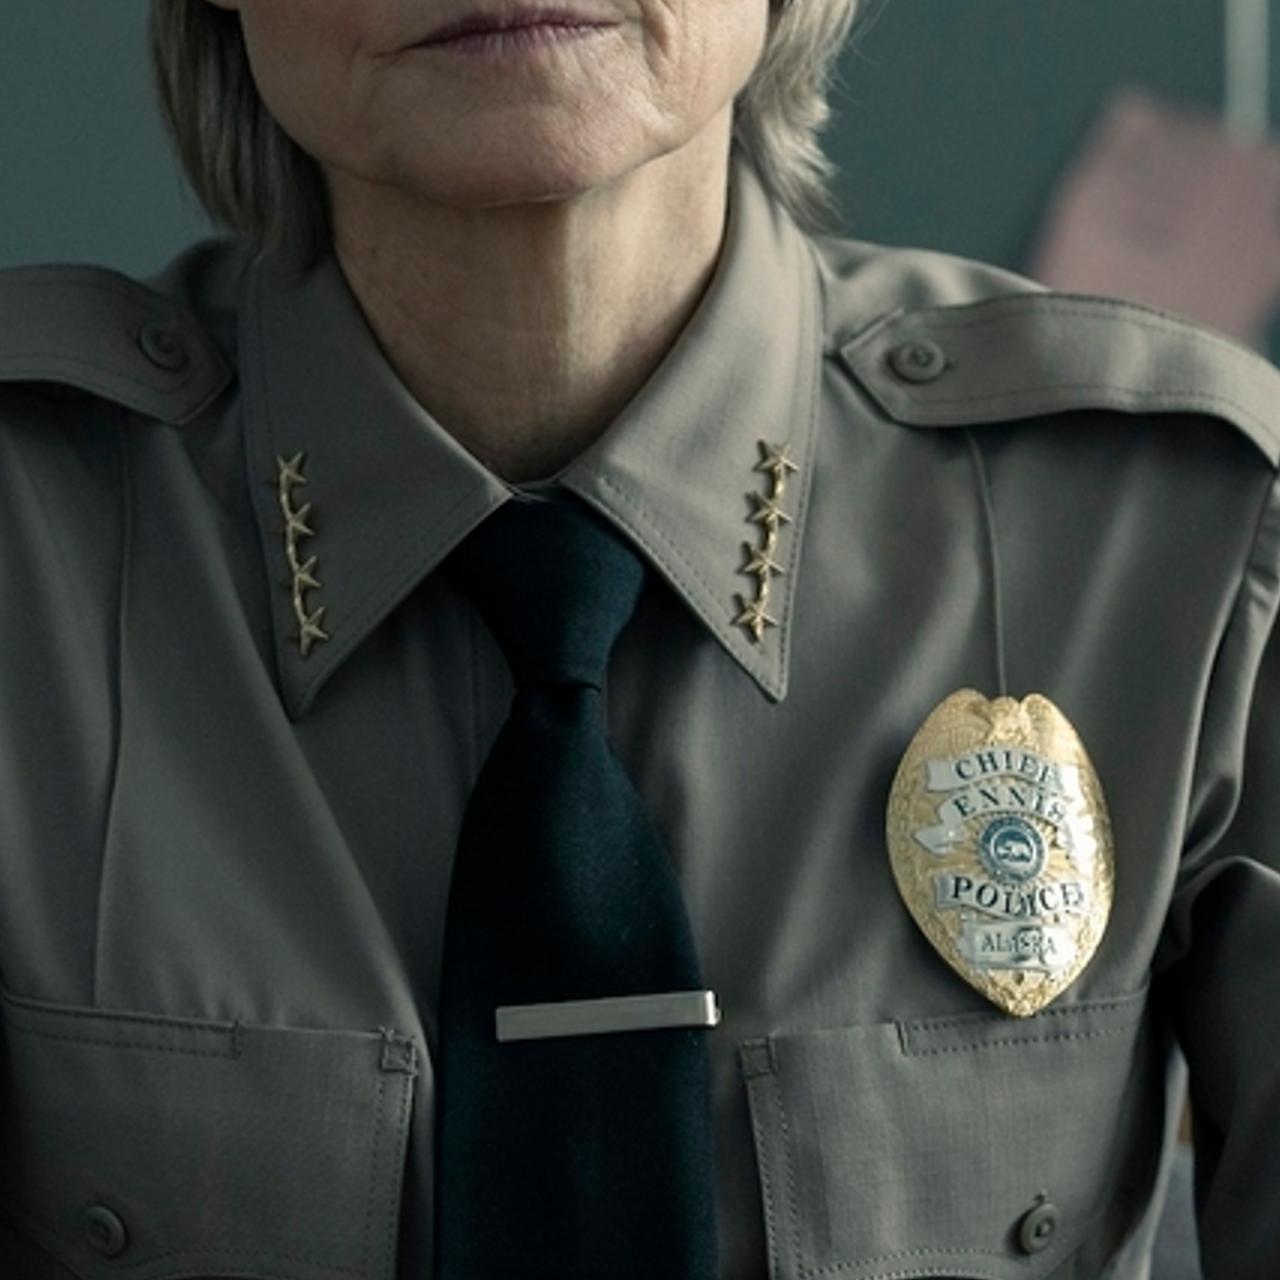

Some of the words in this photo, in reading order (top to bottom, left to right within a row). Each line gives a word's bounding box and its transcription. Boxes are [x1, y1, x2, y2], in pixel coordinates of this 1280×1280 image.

[954, 750, 1056, 783] CHIEF
[953, 780, 1065, 821] ENNIS
[952, 875, 1084, 916] POLICE
